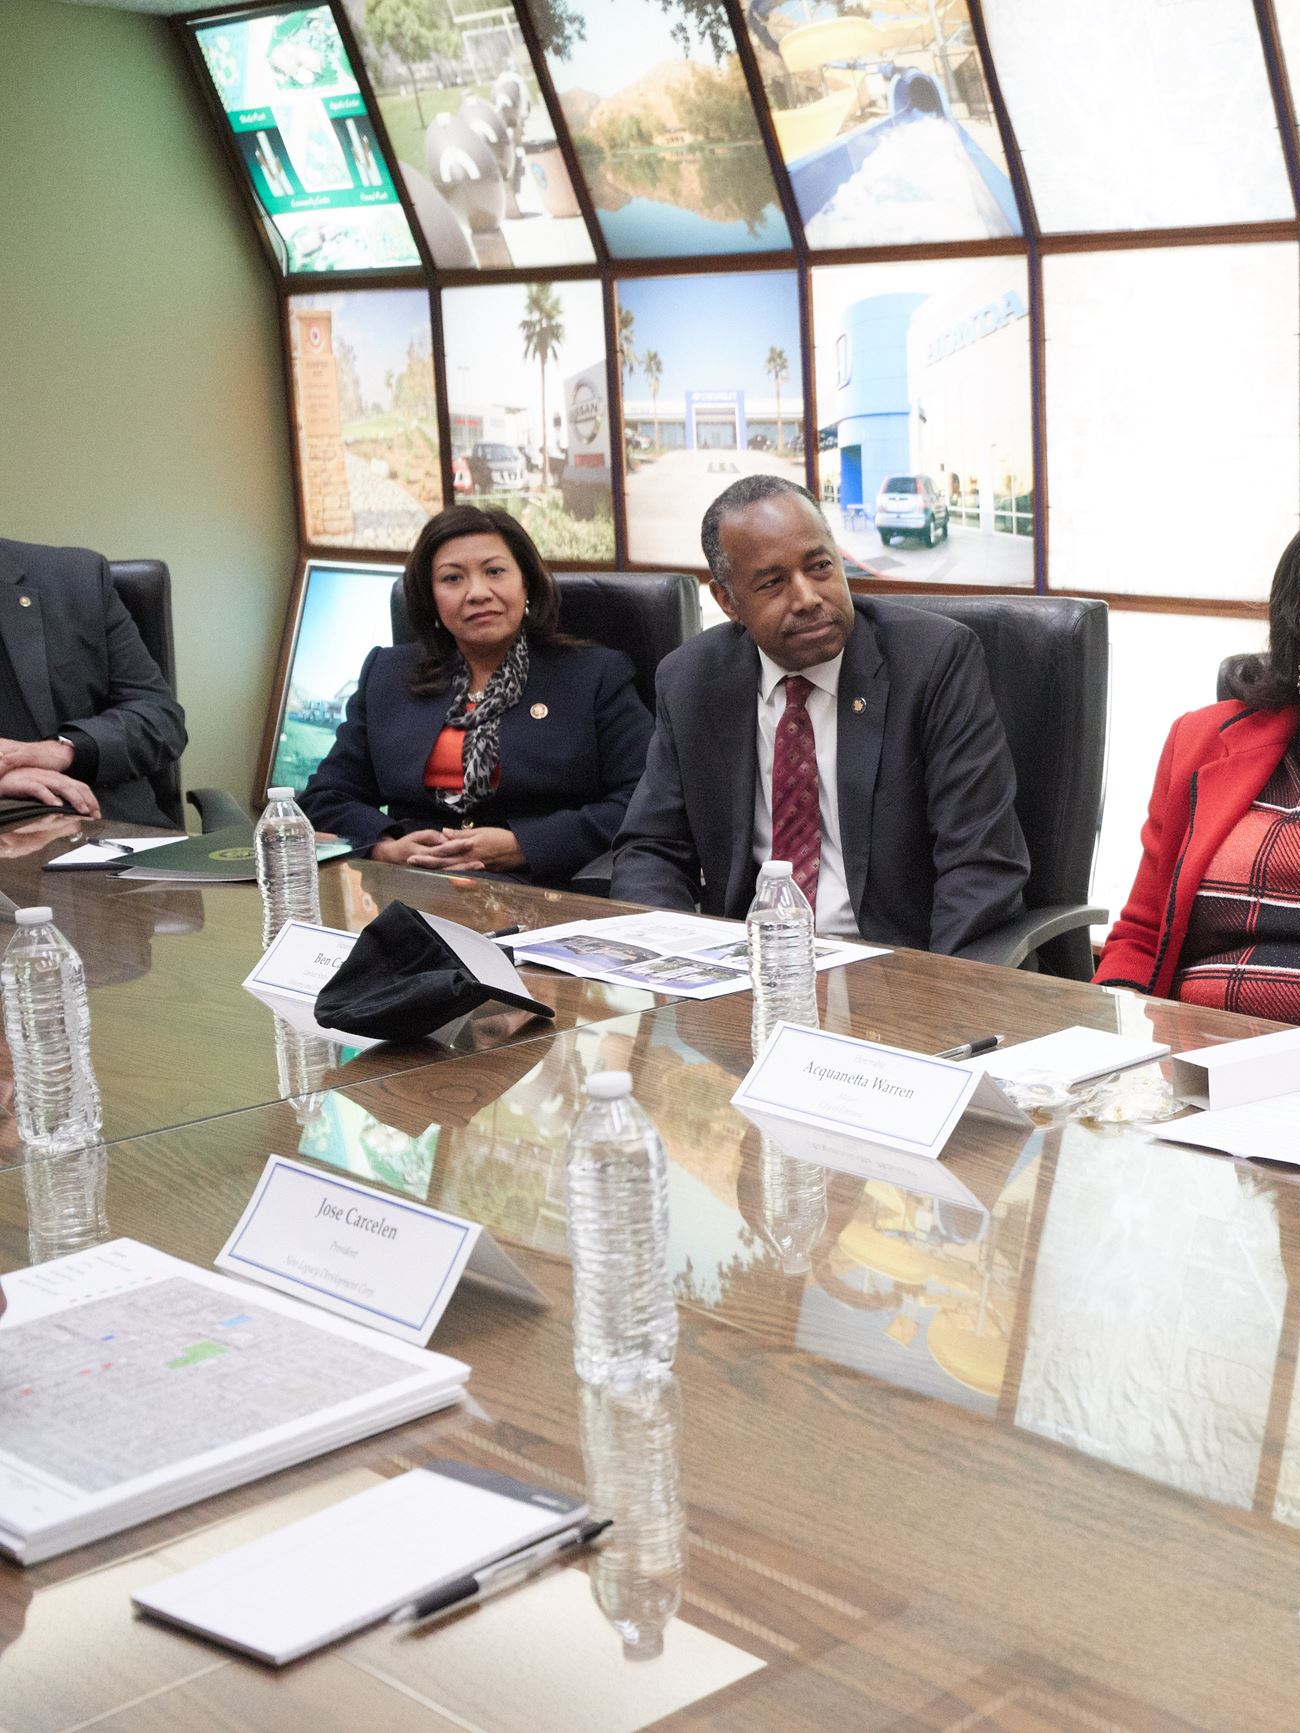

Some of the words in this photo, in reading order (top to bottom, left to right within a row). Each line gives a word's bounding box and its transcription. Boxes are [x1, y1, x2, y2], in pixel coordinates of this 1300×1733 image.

[926, 290, 1028, 366] HONDA
[314, 952, 331, 966] Ben
[803, 1061, 869, 1088] Acquanetta
[872, 1077, 914, 1099] Warren
[315, 1197, 343, 1220] Jose
[345, 1207, 398, 1240] Carcelen
